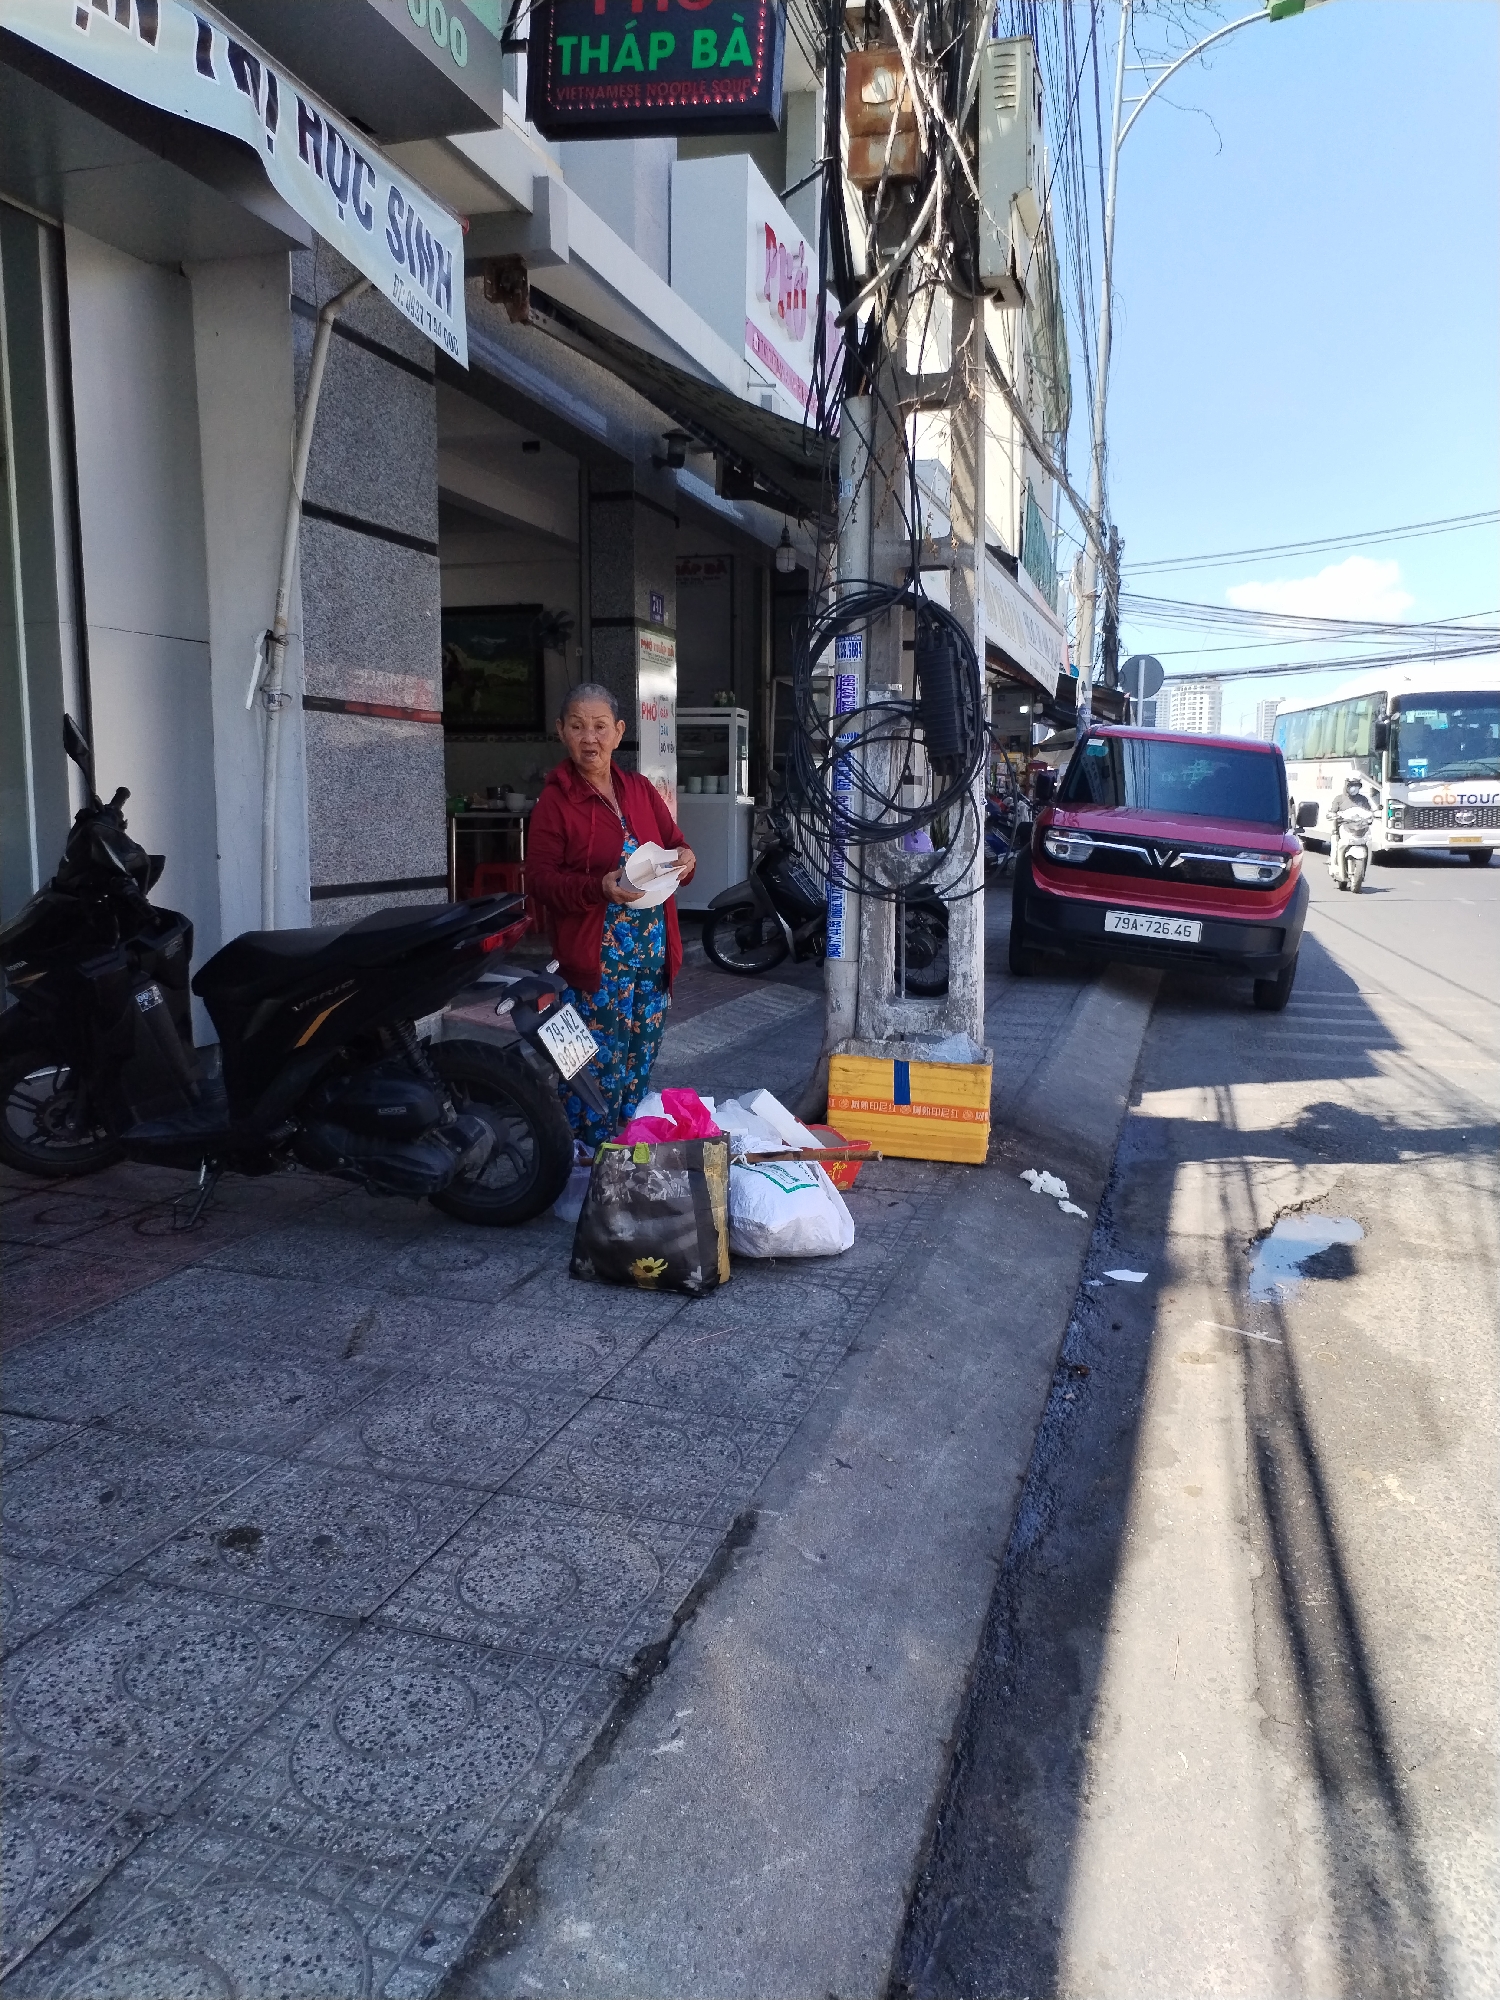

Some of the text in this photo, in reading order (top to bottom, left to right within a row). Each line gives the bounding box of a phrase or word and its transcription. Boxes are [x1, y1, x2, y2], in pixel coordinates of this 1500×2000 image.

[556, 12, 753, 76] THÁP BÀ
[556, 78, 752, 102] VIETNAMESE NOODLE SOUP
[294, 94, 377, 233] HỌC
[385, 184, 453, 320] SINH
[1114, 916, 1192, 938] 79A-726.46
[545, 1009, 580, 1049] 79-N2
[557, 1028, 594, 1073] 987.25
